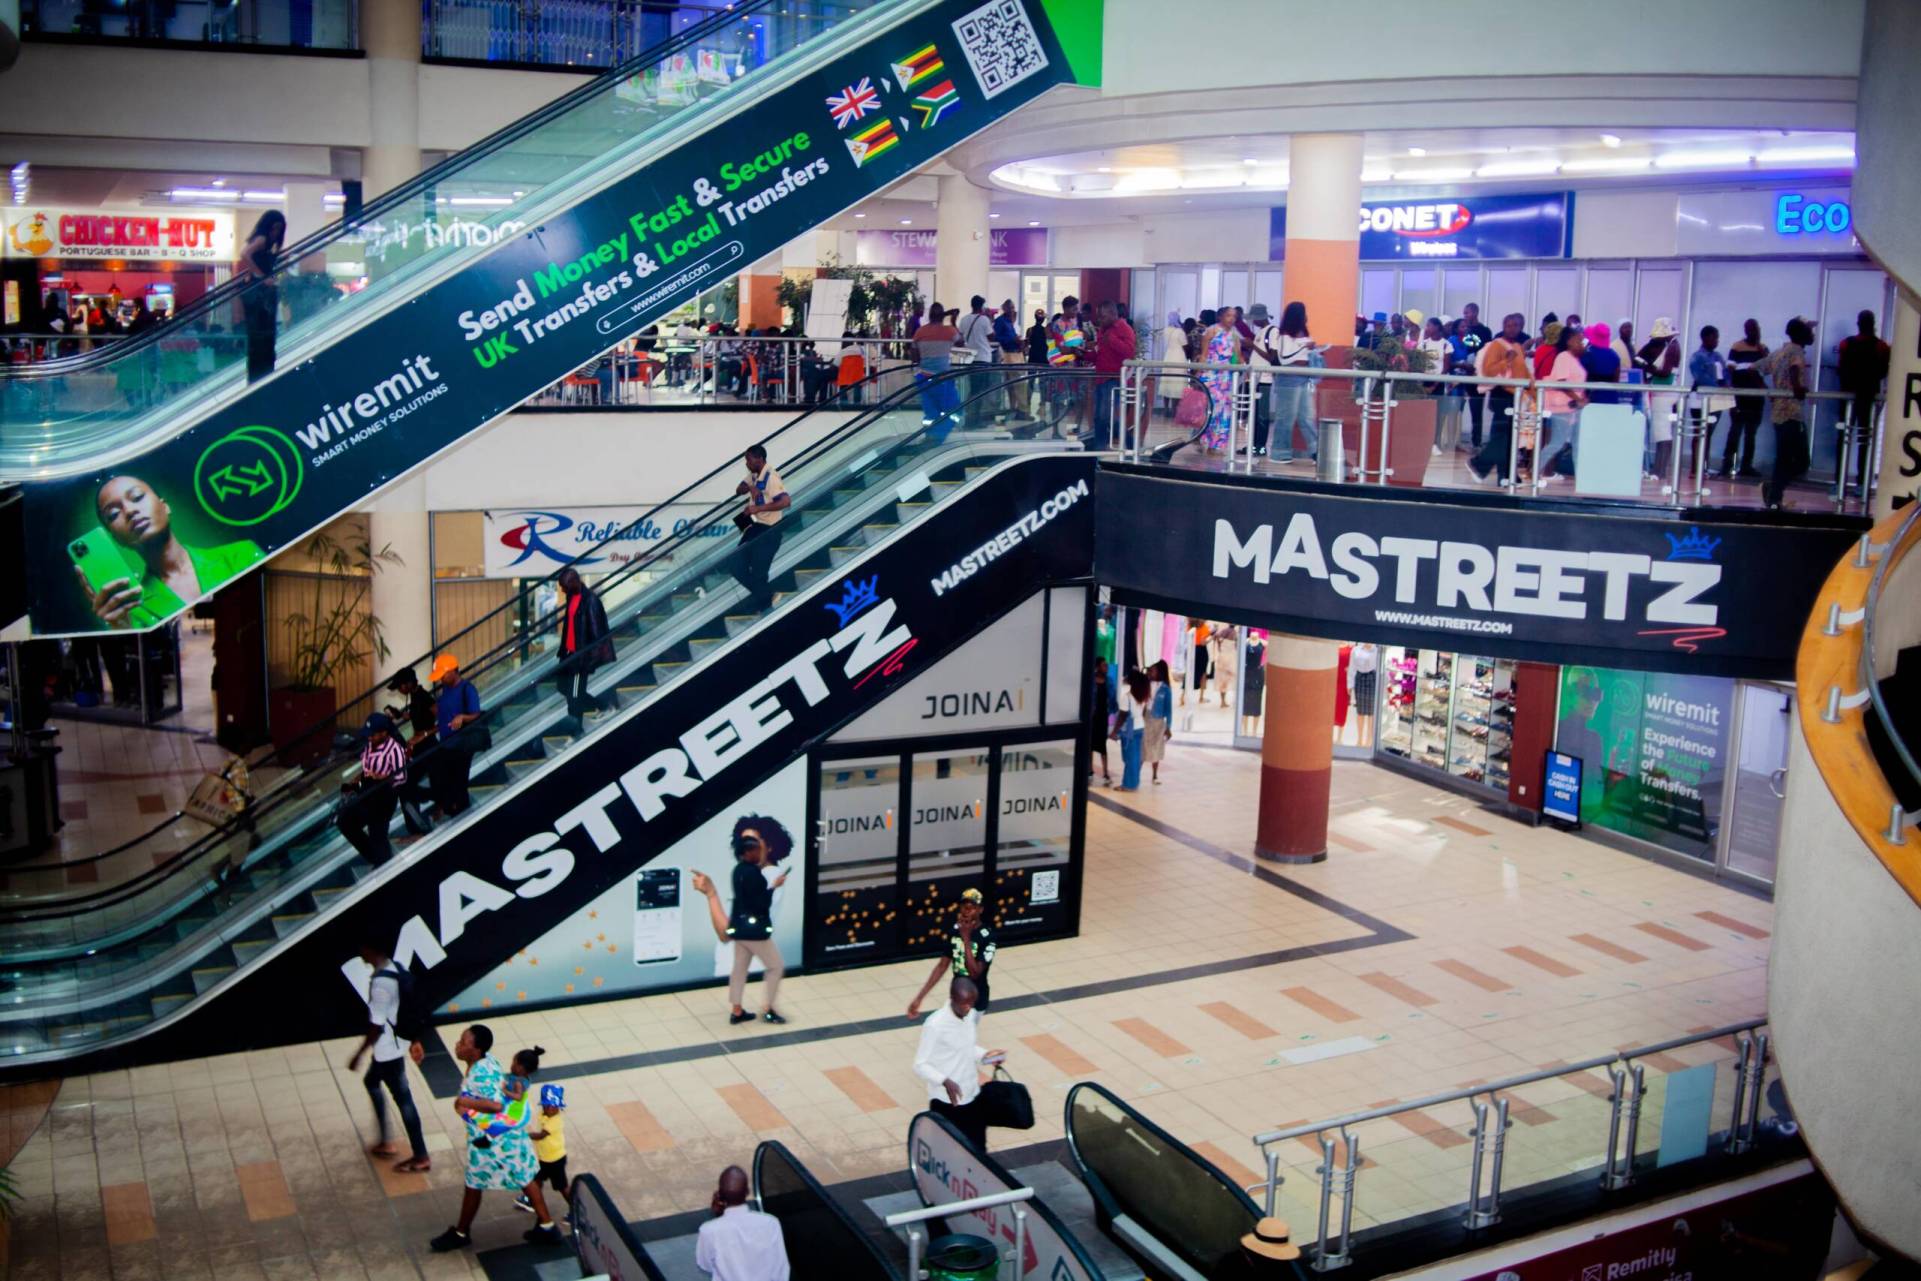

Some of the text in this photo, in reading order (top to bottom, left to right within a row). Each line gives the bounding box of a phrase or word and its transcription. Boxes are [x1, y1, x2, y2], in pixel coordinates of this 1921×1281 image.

[59, 214, 216, 248] CHICKEN-HUT
[1359, 203, 1459, 232] CONET
[59, 247, 126, 256] PORTUGUESE
[129, 248, 151, 256] BAR
[190, 249, 216, 257] SHOP
[458, 278, 536, 341] Send
[532, 232, 628, 299] Money
[629, 194, 694, 242] Fast
[693, 177, 723, 207] &
[720, 131, 811, 192] Secure
[472, 157, 830, 369] UK Transfers & Local Transfers
[630, 262, 711, 313] www.wiremit.com
[295, 354, 440, 450] wiremit
[311, 382, 449, 467] SMART MONEY SOLUTIONS
[930, 478, 1090, 597] MASTREETZ.COM
[1212, 512, 1722, 627] MASTREETZ
[1374, 608, 1513, 635] WWW.MASTREETZ.COM
[1646, 691, 1720, 726] wiremit
[1642, 742, 1665, 759] the
[1644, 727, 1717, 758] Experience
[1640, 758, 1656, 771] of
[341, 598, 913, 1005] MASTREETZ
[1640, 771, 1702, 801] Transfers.
[1607, 1247, 1677, 1281] Remitly
